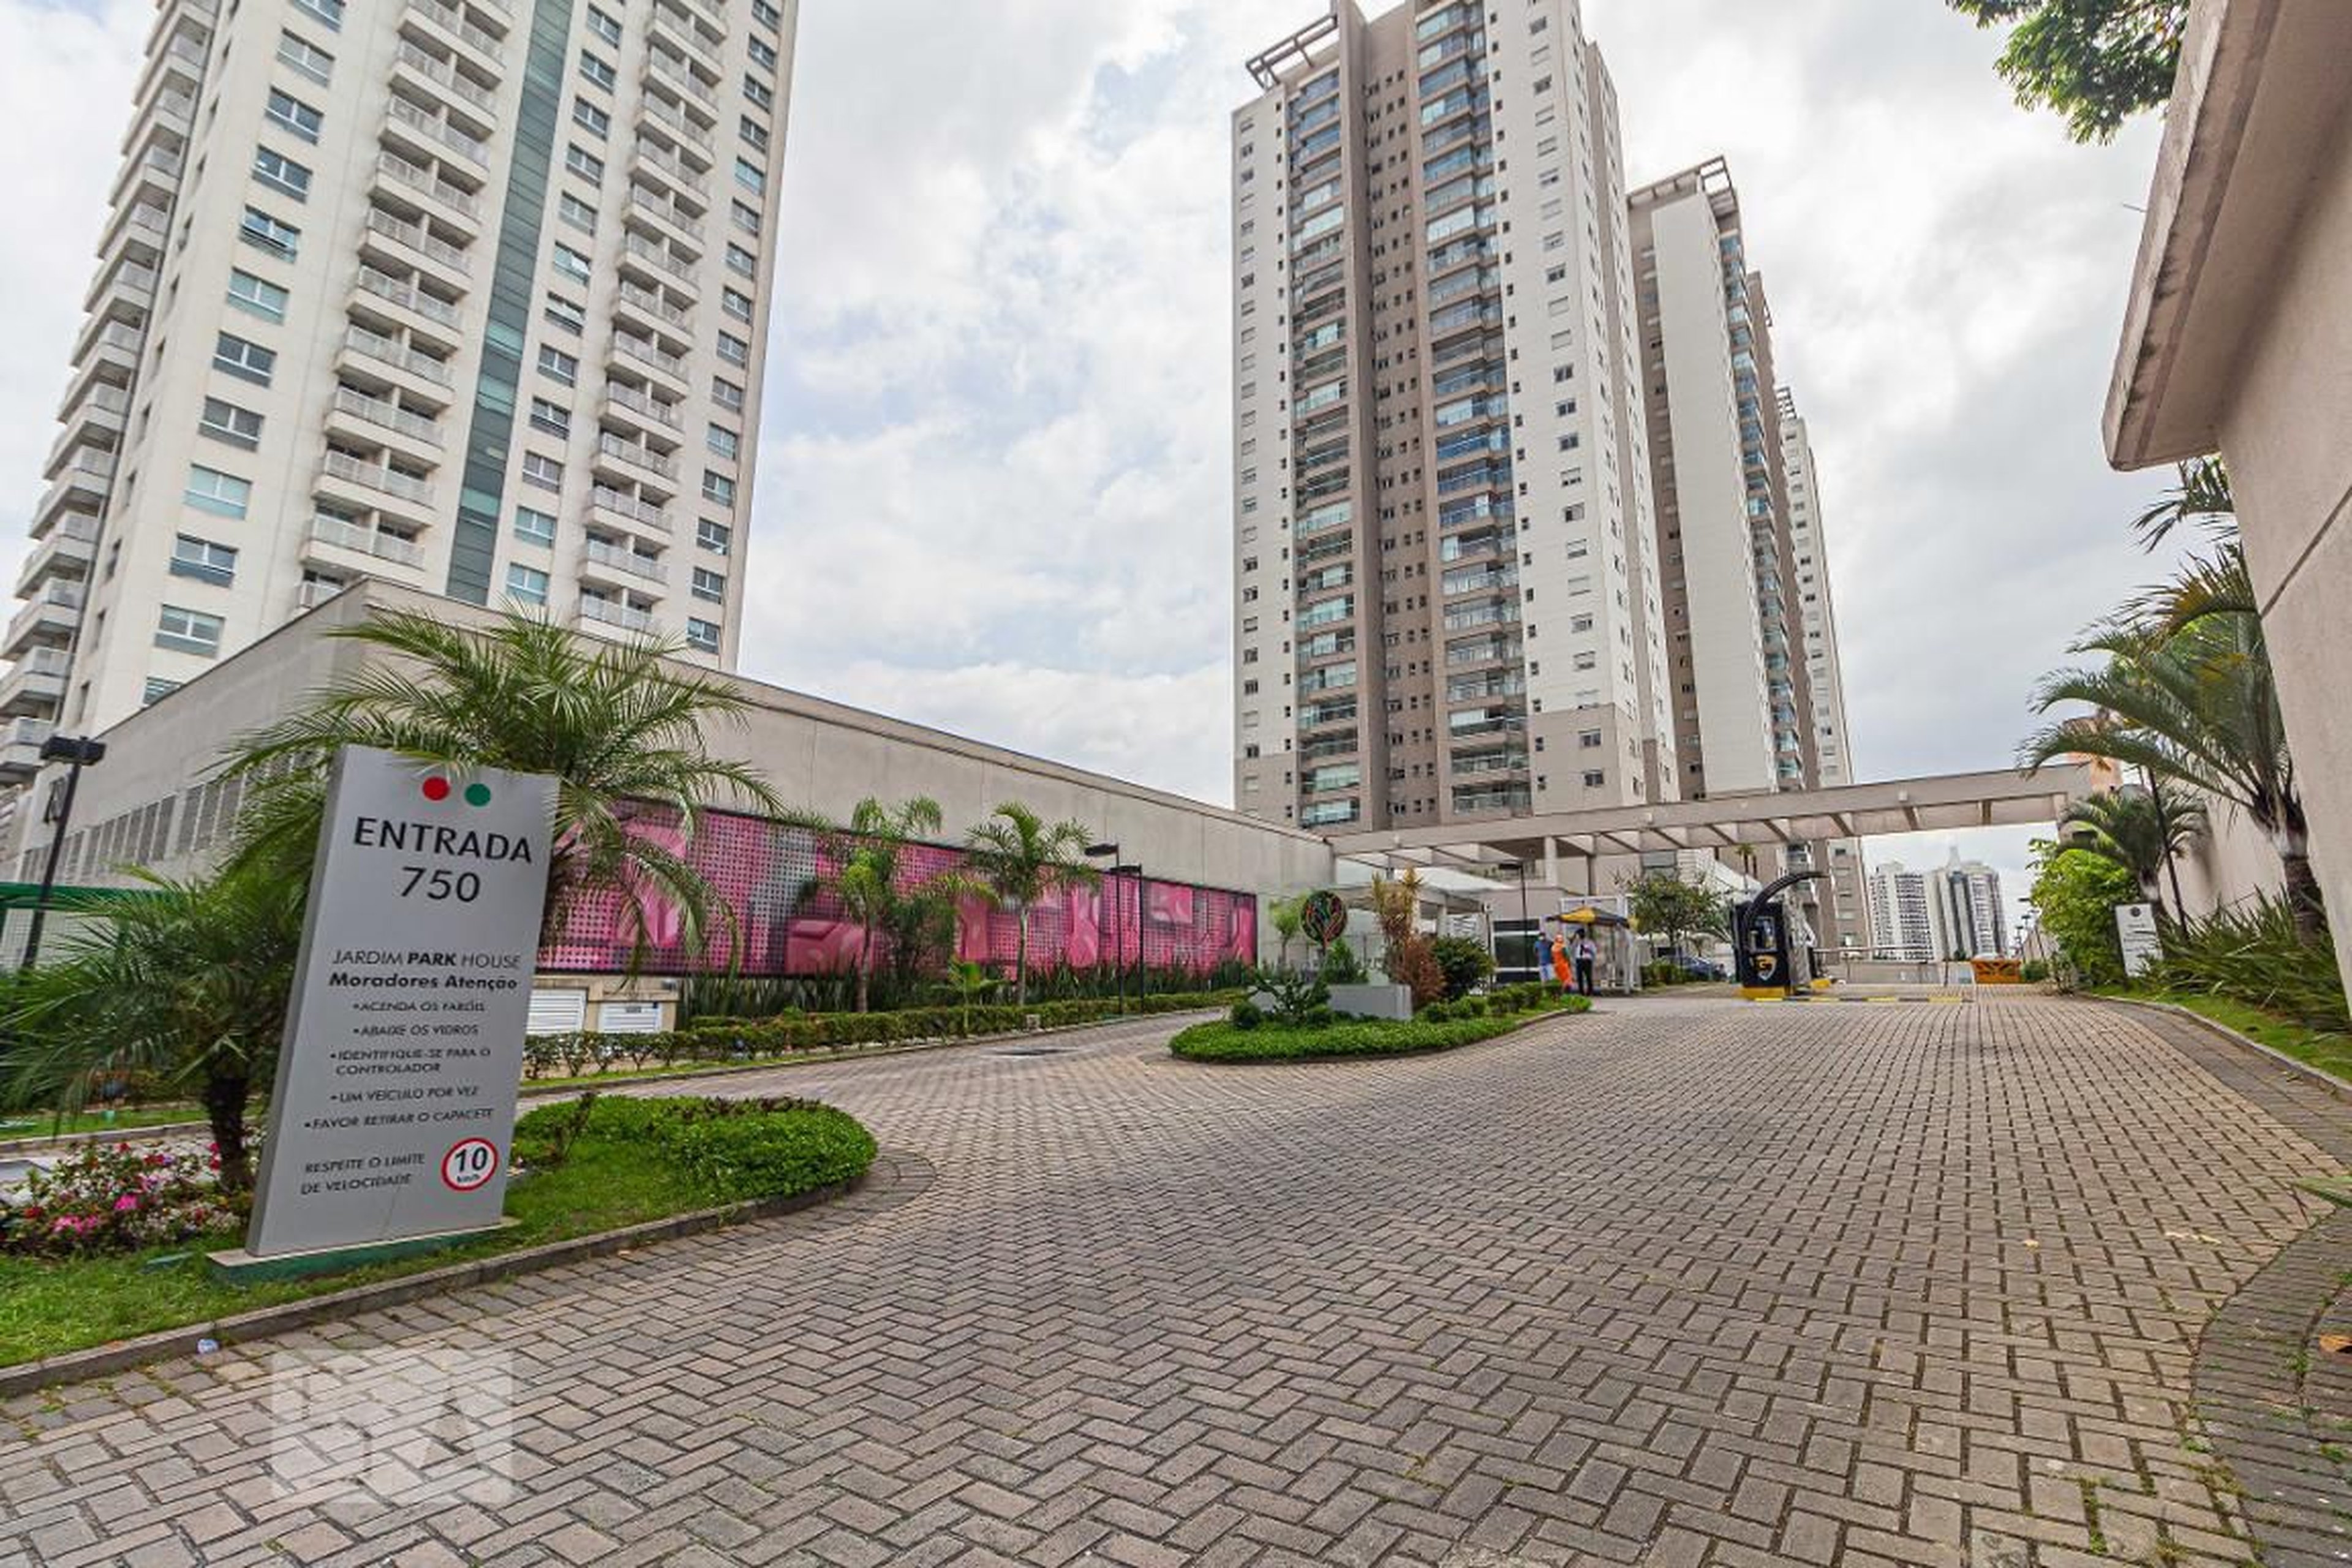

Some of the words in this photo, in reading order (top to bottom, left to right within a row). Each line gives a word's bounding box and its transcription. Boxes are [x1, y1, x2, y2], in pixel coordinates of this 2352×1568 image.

[353, 816, 532, 863] ENTRADA
[401, 866, 480, 902] 750
[332, 951, 402, 965] JARDIM
[407, 952, 456, 966] PARK
[461, 954, 521, 970] HOUSE
[329, 973, 438, 989] Moradores
[445, 974, 518, 992] Atenção
[360, 1001, 416, 1011] ACENDA
[360, 1025, 407, 1036] ABAIXE
[410, 1025, 429, 1036] OS
[433, 1024, 480, 1036] VIDROS
[446, 1049, 477, 1058] PARA
[479, 1048, 491, 1057] O
[336, 1063, 441, 1076] CONTROLADOR
[339, 1091, 364, 1103] UM
[428, 1087, 454, 1098] POR
[458, 1086, 479, 1097] VEZ
[312, 1116, 360, 1129] FAVOR
[364, 1112, 415, 1126] RETIRAR
[418, 1112, 430, 1122] O
[433, 1108, 494, 1122] CAPACETE
[305, 1159, 363, 1174] RESPEITE
[369, 1156, 382, 1169] O
[385, 1153, 426, 1166] LIMITE
[454, 1146, 489, 1172] 10
[300, 1182, 321, 1196] DE
[325, 1173, 412, 1191] VELOCIDADE
